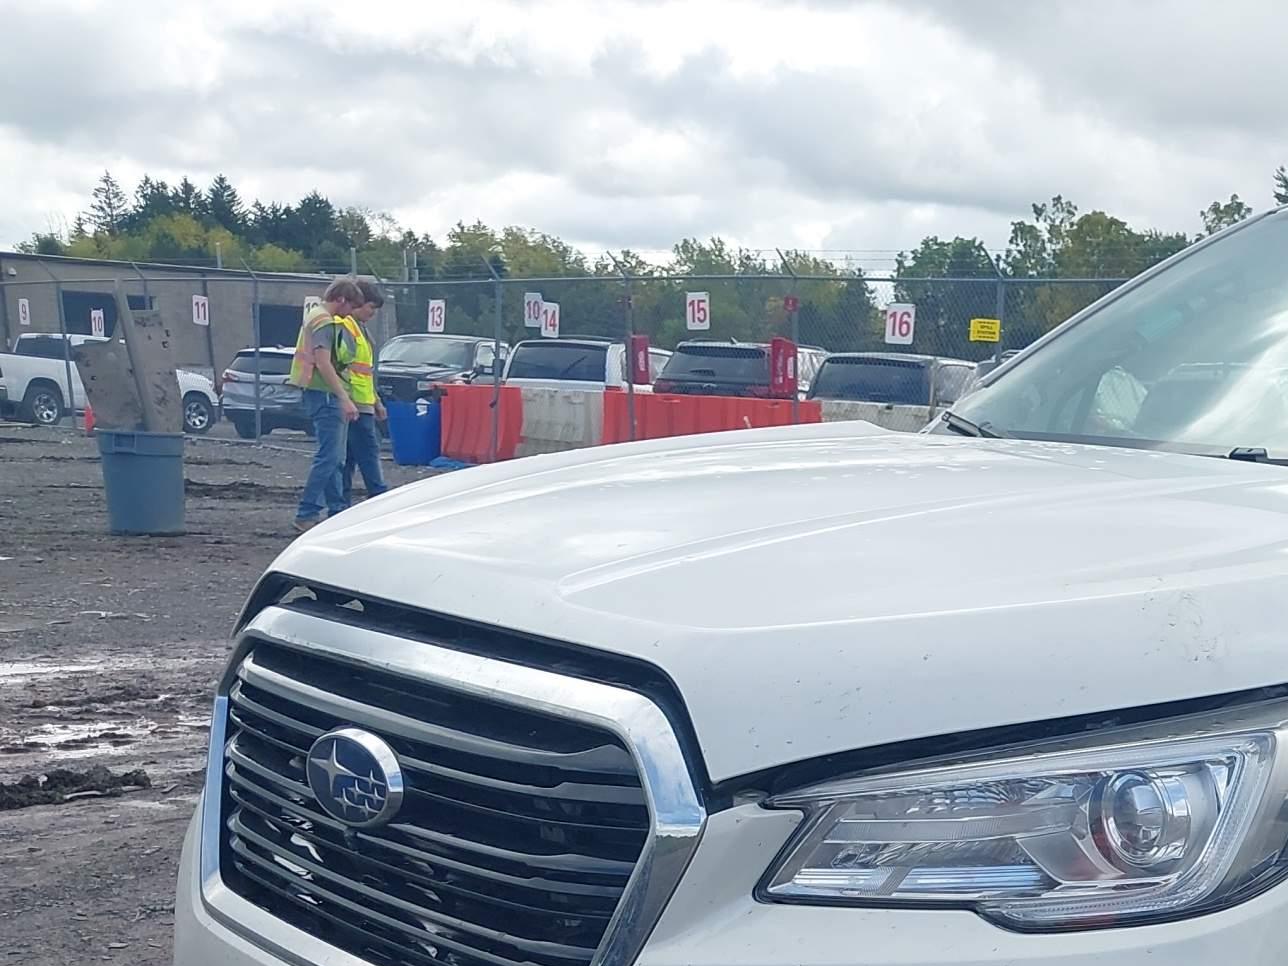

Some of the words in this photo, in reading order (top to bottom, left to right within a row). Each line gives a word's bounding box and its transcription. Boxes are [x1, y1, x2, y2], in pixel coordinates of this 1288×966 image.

[21, 303, 28, 321] 9
[194, 301, 207, 321] 11
[430, 305, 443, 327] 13
[526, 300, 540, 321] 10
[542, 309, 557, 332] 14
[687, 299, 707, 324] 15
[92, 315, 103, 333] 10
[889, 311, 912, 338] 16
